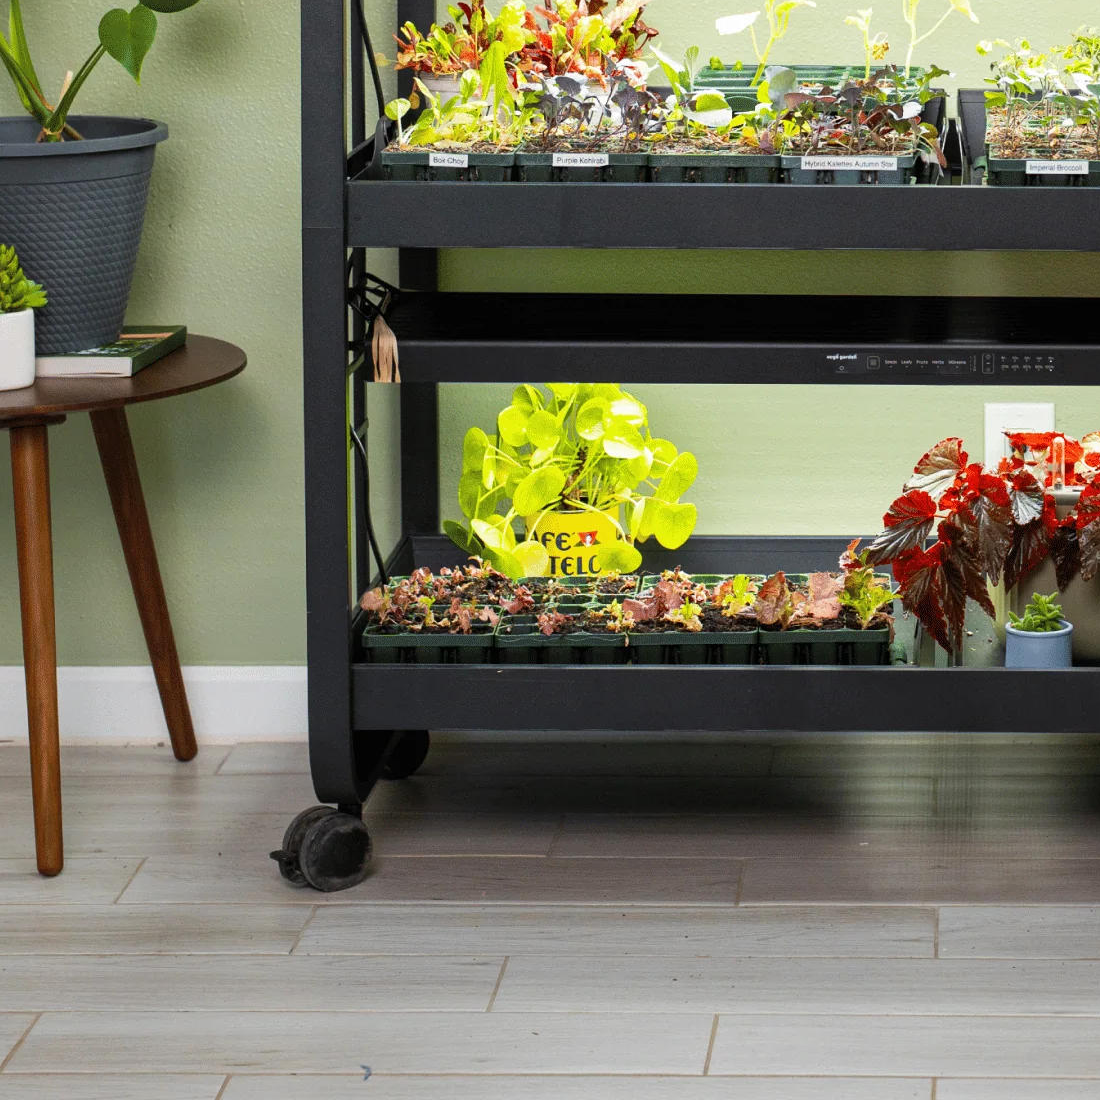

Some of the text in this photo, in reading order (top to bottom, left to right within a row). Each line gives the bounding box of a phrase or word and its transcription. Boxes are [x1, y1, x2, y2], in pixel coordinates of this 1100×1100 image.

[433, 156, 465, 166] Bok Choy
[556, 157, 578, 165] Purple
[804, 160, 826, 168] Hybrid
[880, 160, 894, 168] Star
[1030, 164, 1056, 172] Imperial
